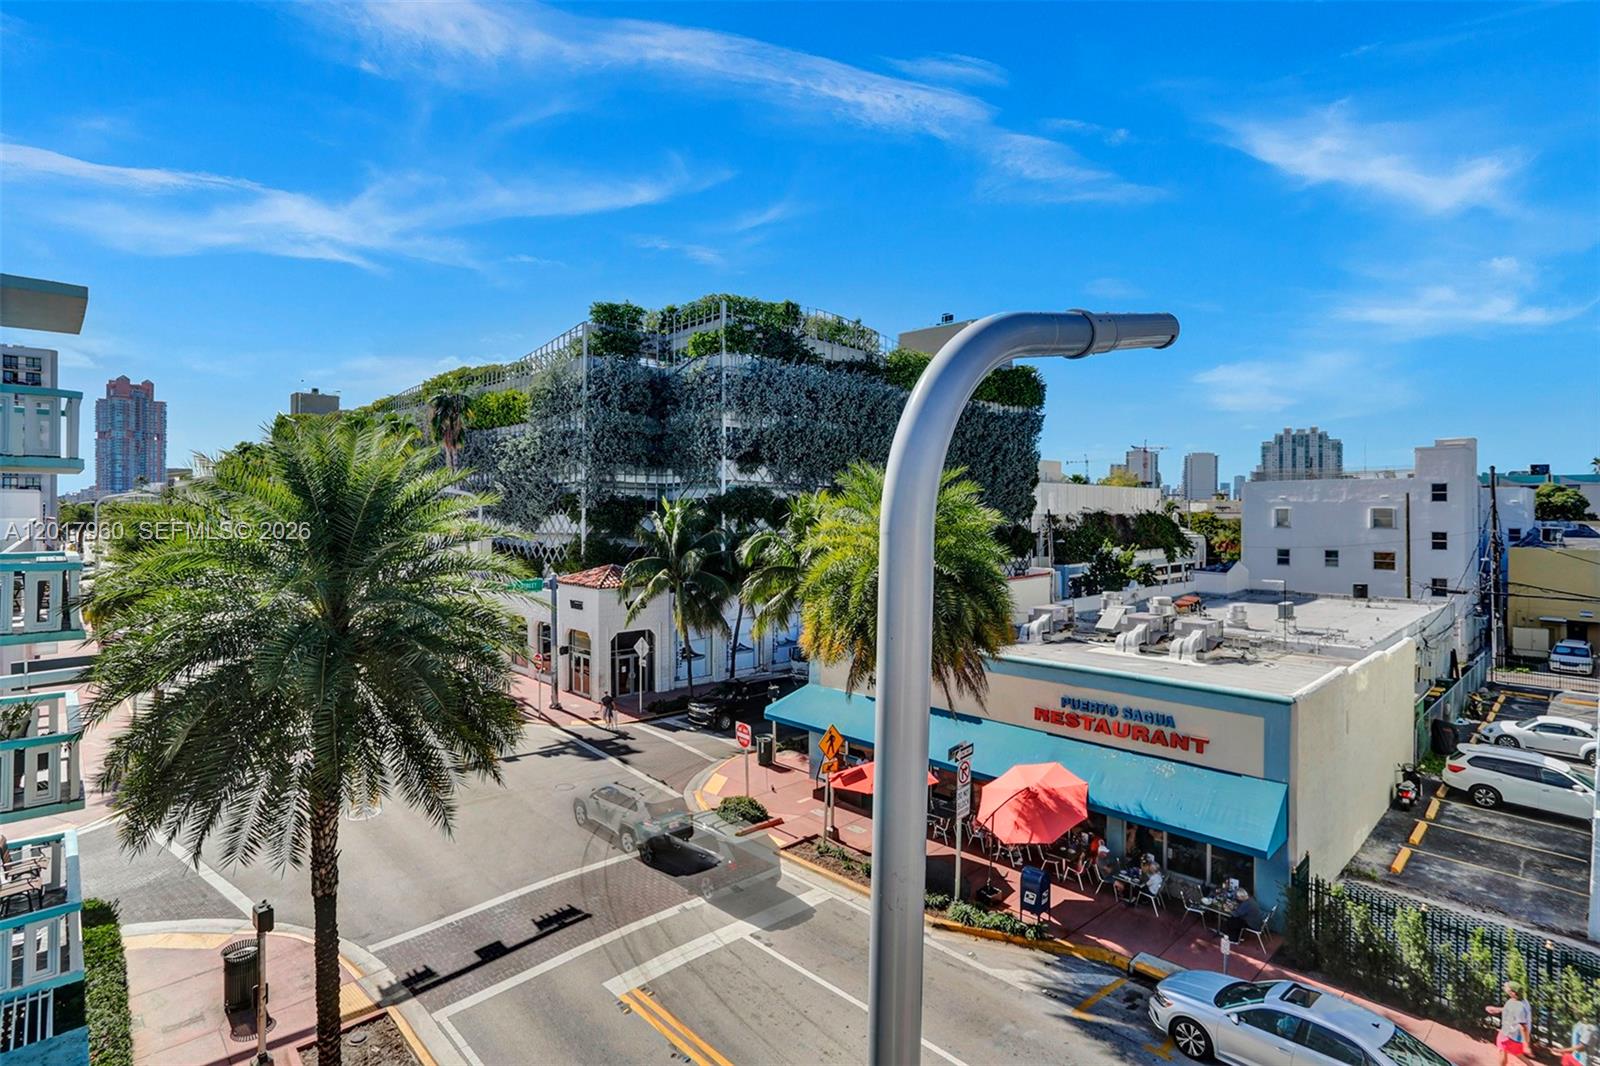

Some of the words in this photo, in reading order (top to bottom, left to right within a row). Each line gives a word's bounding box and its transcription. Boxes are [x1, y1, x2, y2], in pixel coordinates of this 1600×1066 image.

[1034, 707, 1210, 754] RESTAURANT
[1060, 696, 1119, 717] PUERTO
[1122, 707, 1176, 728] SAGUA
